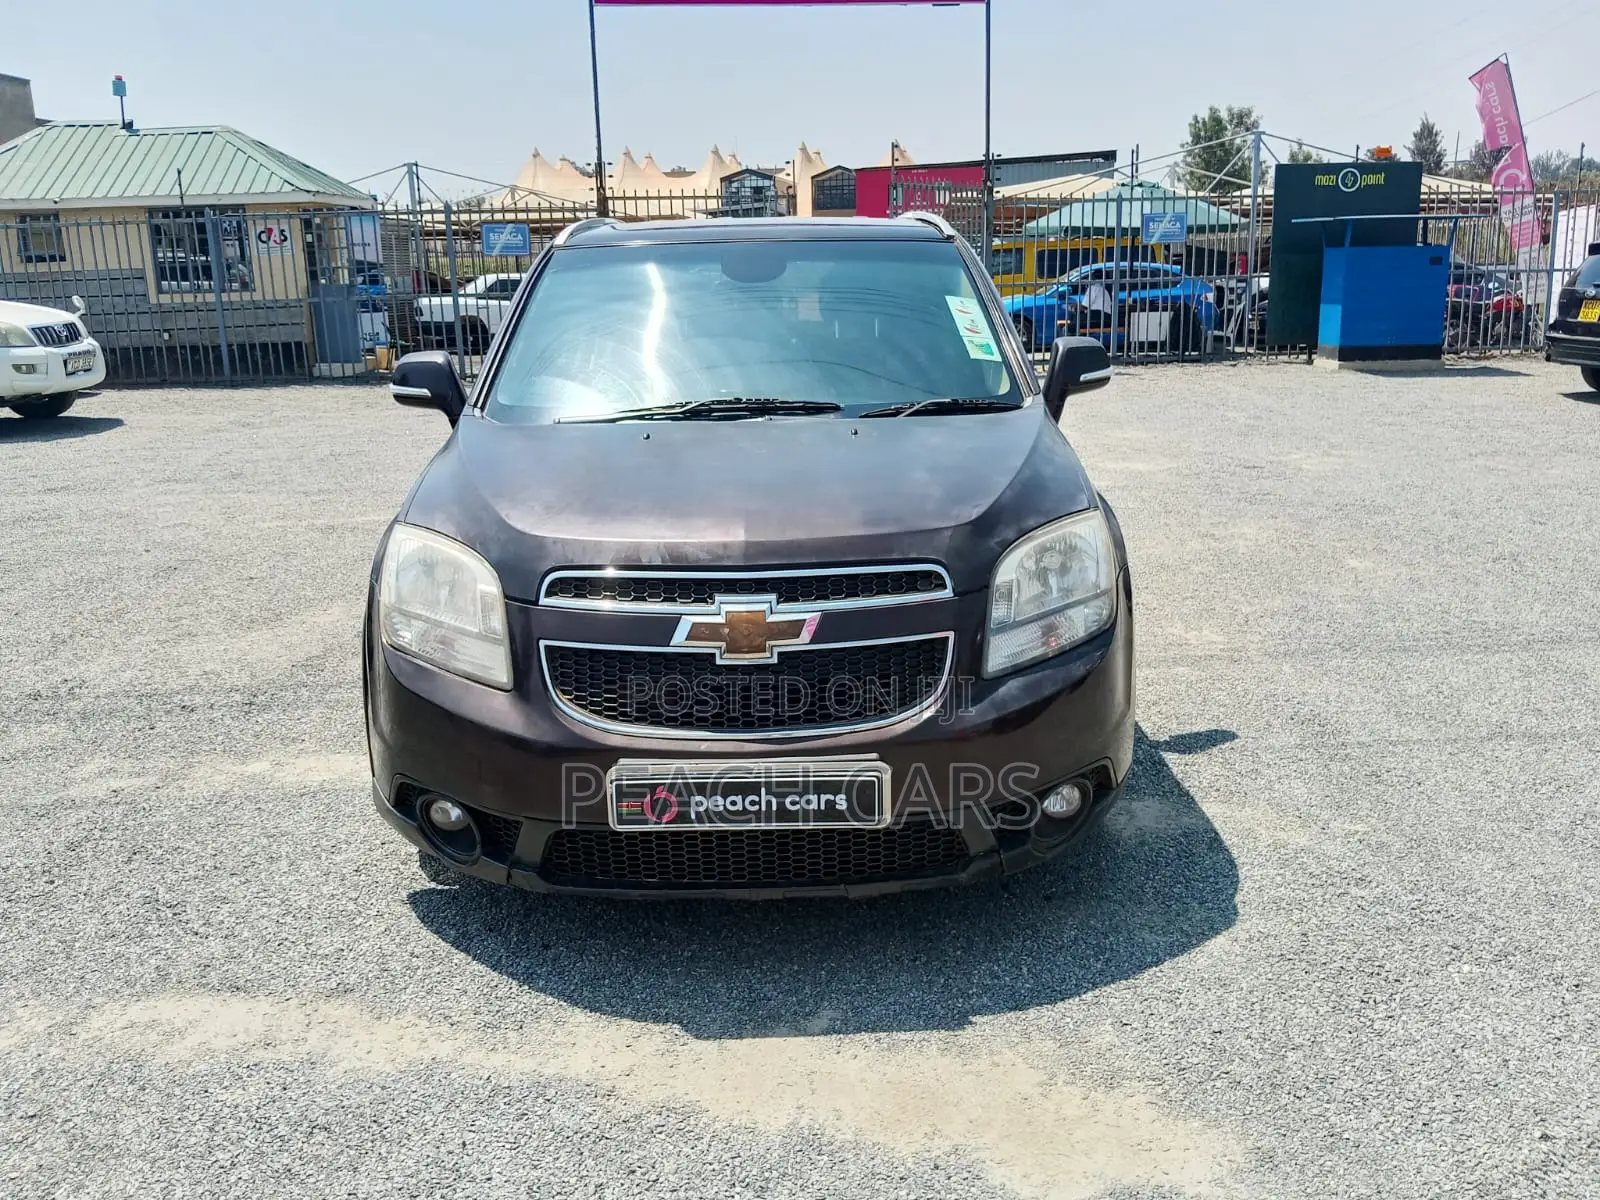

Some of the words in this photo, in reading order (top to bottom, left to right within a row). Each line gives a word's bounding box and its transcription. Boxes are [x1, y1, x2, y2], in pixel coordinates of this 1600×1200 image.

[1360, 171, 1385, 188] point
[689, 787, 778, 819] peach
[785, 790, 848, 811] cars
